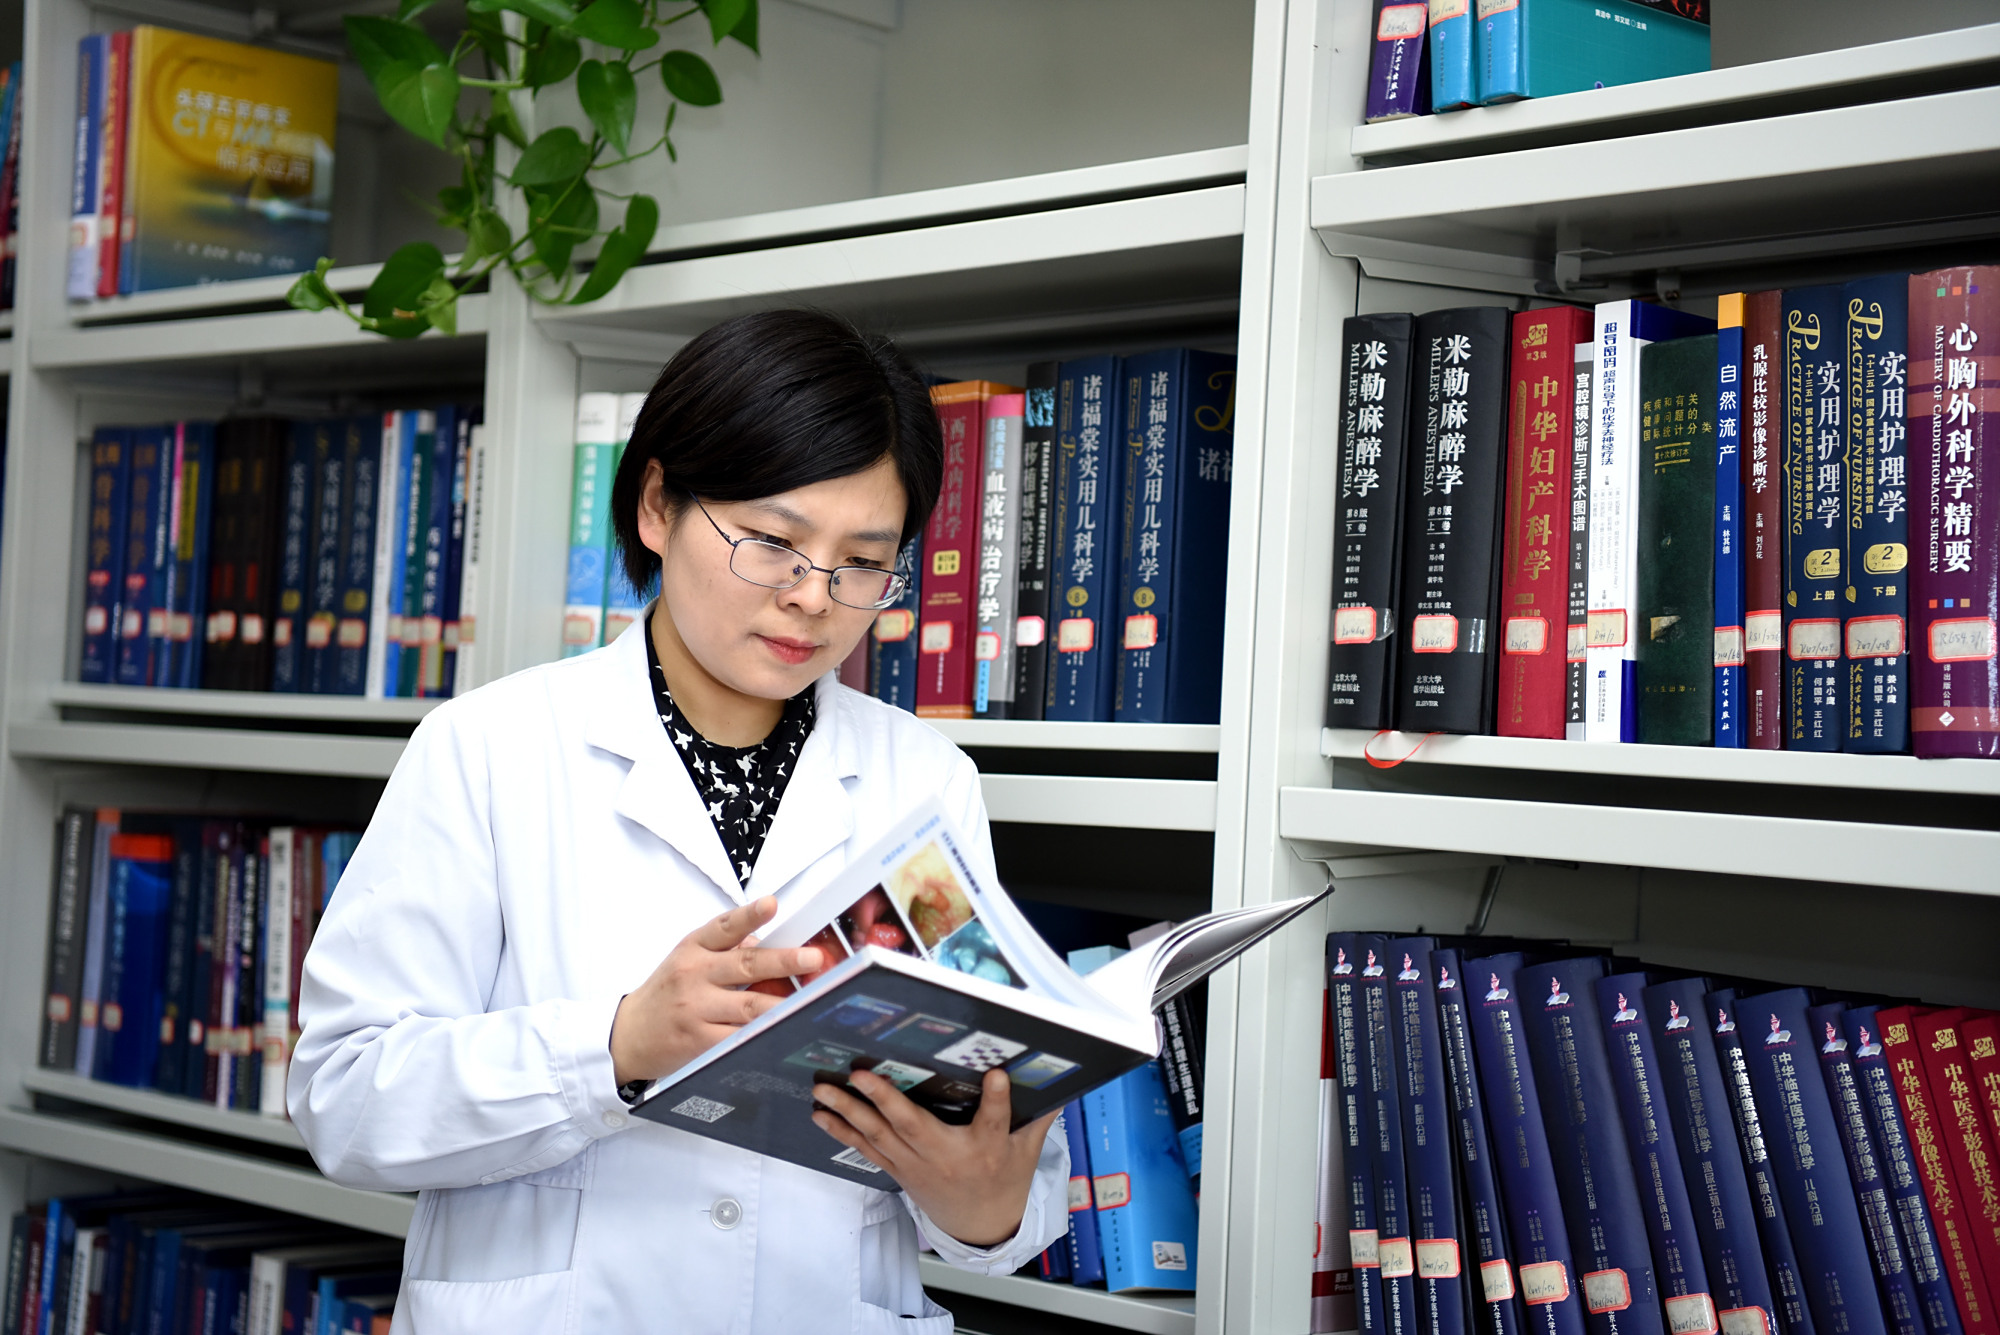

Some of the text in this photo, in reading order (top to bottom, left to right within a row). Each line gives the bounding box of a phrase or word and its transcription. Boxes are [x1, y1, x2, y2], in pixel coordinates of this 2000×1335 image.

[1343, 343, 1361, 498] MILLER'S ANESTHESIA
[1353, 340, 1388, 498] 米勒麻醉学
[1423, 336, 1442, 497] MILLER'S ANESTHESIA
[1436, 334, 1472, 495] 米勒麻醉学
[1572, 372, 1590, 532] 宫腔镜诊断与手术图谱
[1600, 369, 1616, 466] 超声引导下的化学去神经疗法
[1643, 393, 1699, 413] 疾病和有关
[1643, 408, 1698, 428] 健康问题的
[1643, 421, 1712, 442] 国际统计分类
[1718, 364, 1738, 466] 自然流产
[1752, 344, 1769, 494] 乳腺比较影像诊断学
[1788, 309, 1821, 536] PRACTICE OF NURSING
[1817, 360, 1841, 529] 实用护理学
[1848, 298, 1884, 530] PRACTICE OF NURSING
[1865, 398, 1875, 514] 国家重点图书出版规划项目
[1878, 351, 1907, 524] 实用护理学
[1929, 324, 1945, 574] MASTERY OF CARDIOTHORACIC SURGERY
[1943, 322, 1978, 574] 心胸外科学精要
[1036, 440, 1050, 570] TRANSPLANT INFECTIONS
[1071, 373, 1103, 584] 诸福棠实用儿科学
[1138, 371, 1169, 584] 诸福棠实用儿科学
[1346, 507, 1368, 518] 第8版
[1427, 505, 1453, 517] 第8版
[1523, 375, 1558, 581] 中华妇产科学
[1723, 504, 1731, 522] 主编
[1805, 406, 1814, 520] 国家重点图书出版规划项目
[978, 471, 1008, 623] 血液病治疗学
[1345, 523, 1367, 533] 下卷
[1427, 520, 1451, 532] 上卷
[1574, 542, 1582, 570] 第2版
[1812, 590, 1836, 601] 上册
[1872, 585, 1897, 597] 下册
[1334, 674, 1358, 683] 北京大学
[1413, 684, 1445, 694] 医学出版社
[1416, 674, 1442, 684] 北京大学
[1795, 666, 1804, 740] 人民卫生出版社
[1854, 663, 1864, 738] 人民卫生出版社
[1873, 675, 1883, 704] 何国平
[1887, 657, 1897, 667] 审
[1813, 710, 1823, 738] 王红红
[1873, 708, 1883, 737] 王红红
[1336, 1009, 1344, 1036] CLINICAL
[1340, 982, 1358, 1088] 中华临床医学影像学
[1406, 989, 1425, 1096] 中华临床医学影像学
[1496, 1009, 1525, 1117] 中华临床医学影像学
[1558, 1014, 1587, 1125] 中华临床医学影像学
[1626, 1031, 1659, 1144] 中华临床医学影像学
[1678, 1038, 1713, 1154] 中华临床医学影像学
[1728, 1046, 1776, 1218] 中华临床医学影像学 乳腺分册
[1778, 1051, 1824, 1227] 中华临床医学影像学 儿科分册
[1897, 1058, 1955, 1216] 中华医学影像技术学
[1944, 1063, 2000, 1223] 中华医学影像技术学
[1836, 1061, 1904, 1274] 中华临床医学影像学 医学影像信息学
[1870, 1066, 1940, 1282] 中华临床医学影像学 医学影像信息学
